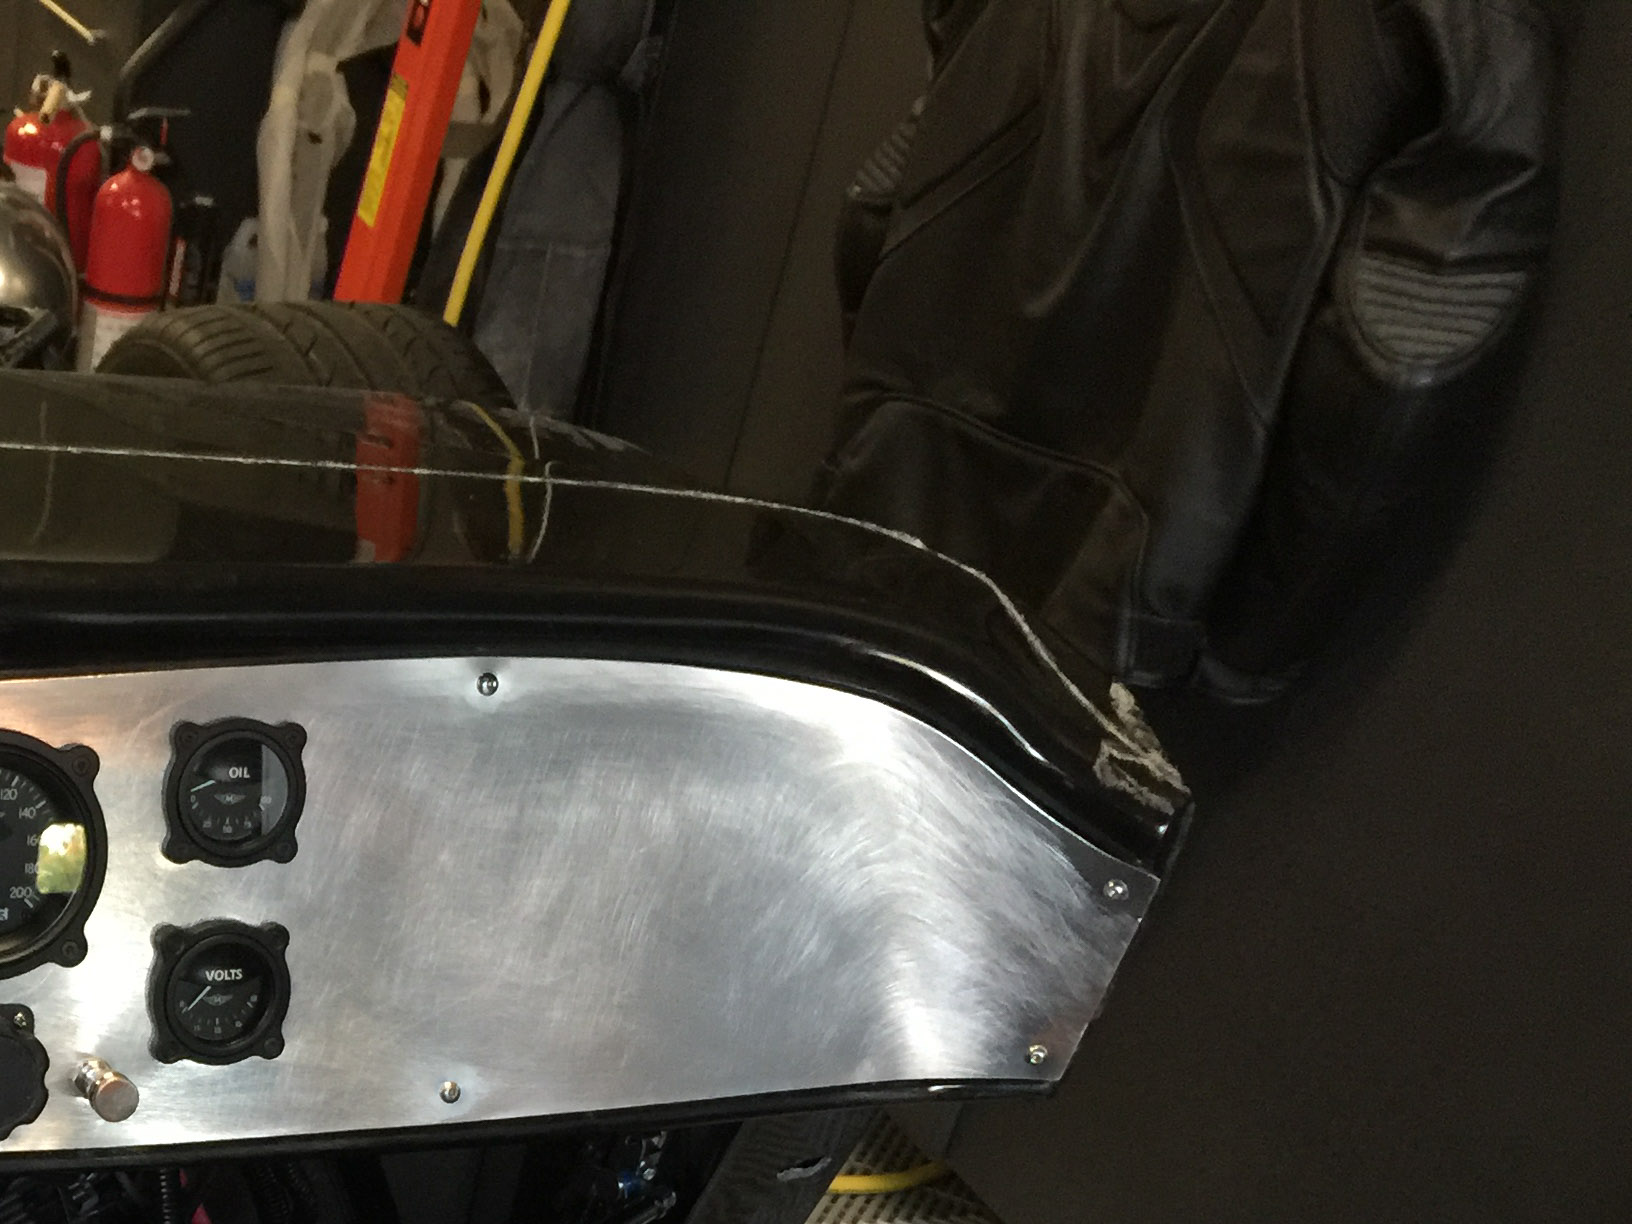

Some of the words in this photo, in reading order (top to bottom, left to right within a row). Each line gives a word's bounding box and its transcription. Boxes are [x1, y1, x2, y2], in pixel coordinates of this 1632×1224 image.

[228, 766, 251, 779] OIL
[0, 787, 18, 801] 120
[18, 806, 37, 820] 140
[10, 886, 32, 899] 200
[204, 968, 244, 981] VOLTS
